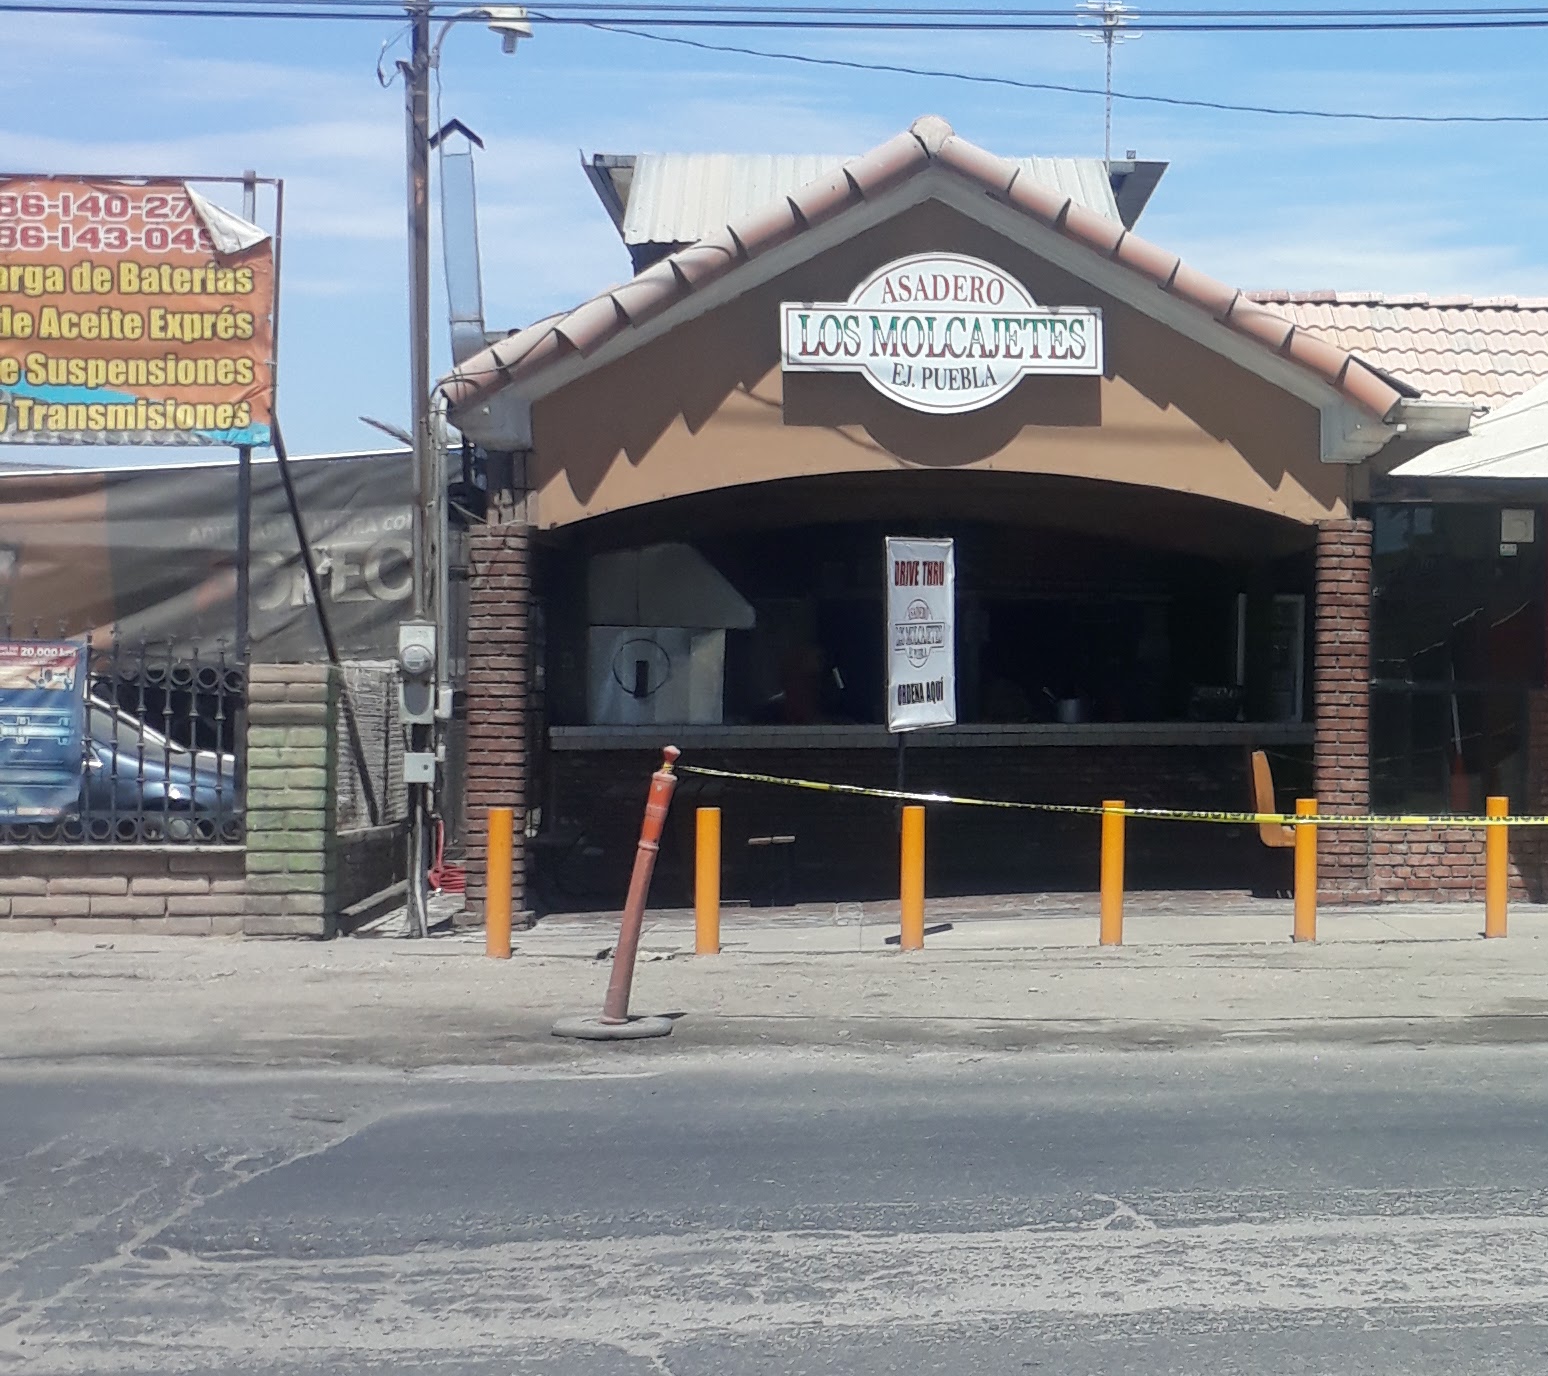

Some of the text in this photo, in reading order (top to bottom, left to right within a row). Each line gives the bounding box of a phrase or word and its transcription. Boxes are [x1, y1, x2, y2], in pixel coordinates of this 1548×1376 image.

[71, 261, 112, 293] de
[118, 261, 254, 294] Baterías
[881, 273, 1005, 305] ASADERO
[39, 306, 143, 340] Aceite
[149, 306, 254, 343] Exprés
[798, 314, 1086, 360] LOS MOLCAJETES
[24, 352, 254, 388] Suspensiones
[891, 363, 998, 391] EJ. PUEBLA
[13, 398, 250, 431] Transmisiones
[894, 560, 945, 586] DRIVE THRU
[897, 677, 945, 706] ORDENA AQUÍ
